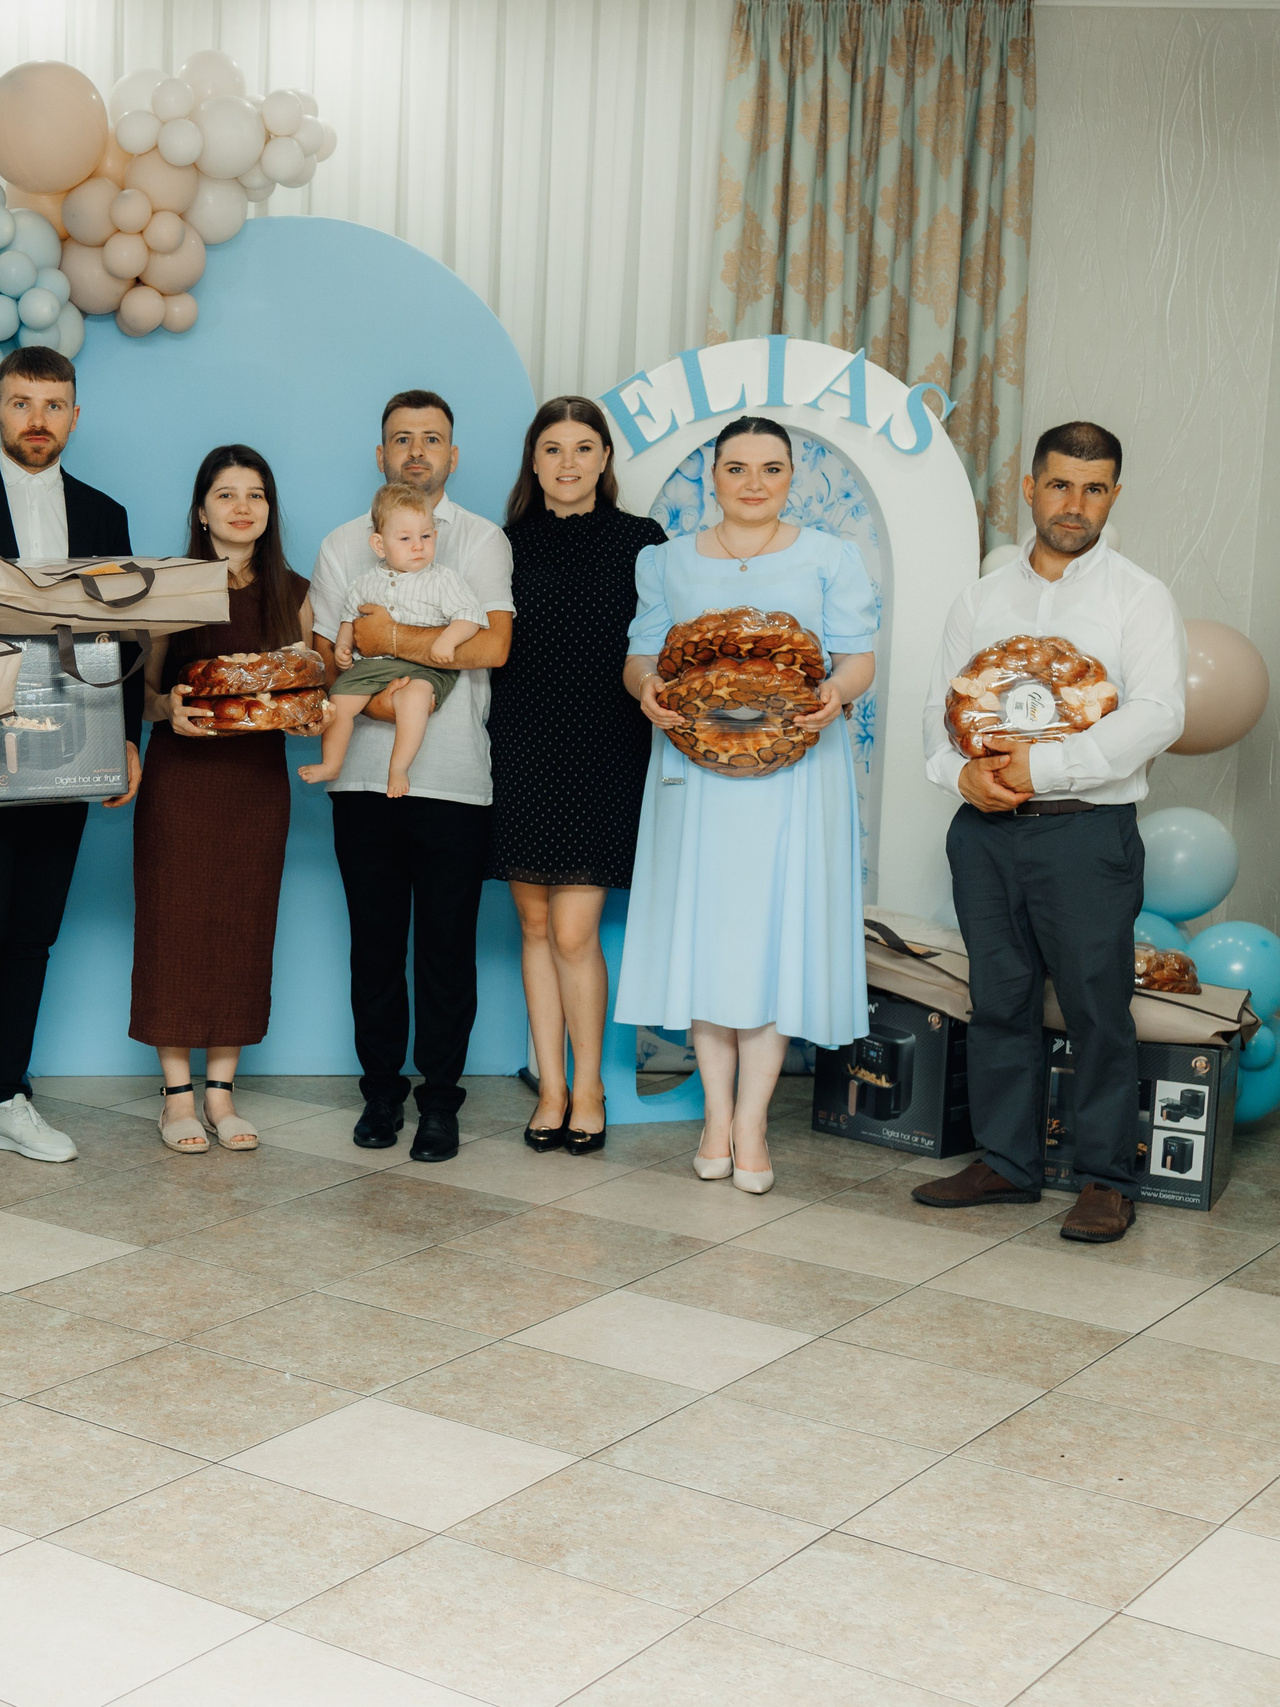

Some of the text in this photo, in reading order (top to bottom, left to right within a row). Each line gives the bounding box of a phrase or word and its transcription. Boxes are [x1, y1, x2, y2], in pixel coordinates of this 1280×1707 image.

[594, 334, 959, 461] ELIAS
[54, 776, 77, 786] Digital
[93, 775, 102, 783] air
[104, 774, 122, 783] fryer
[900, 1132, 911, 1141] hot
[1140, 1190, 1201, 1204] www.bestron.com
